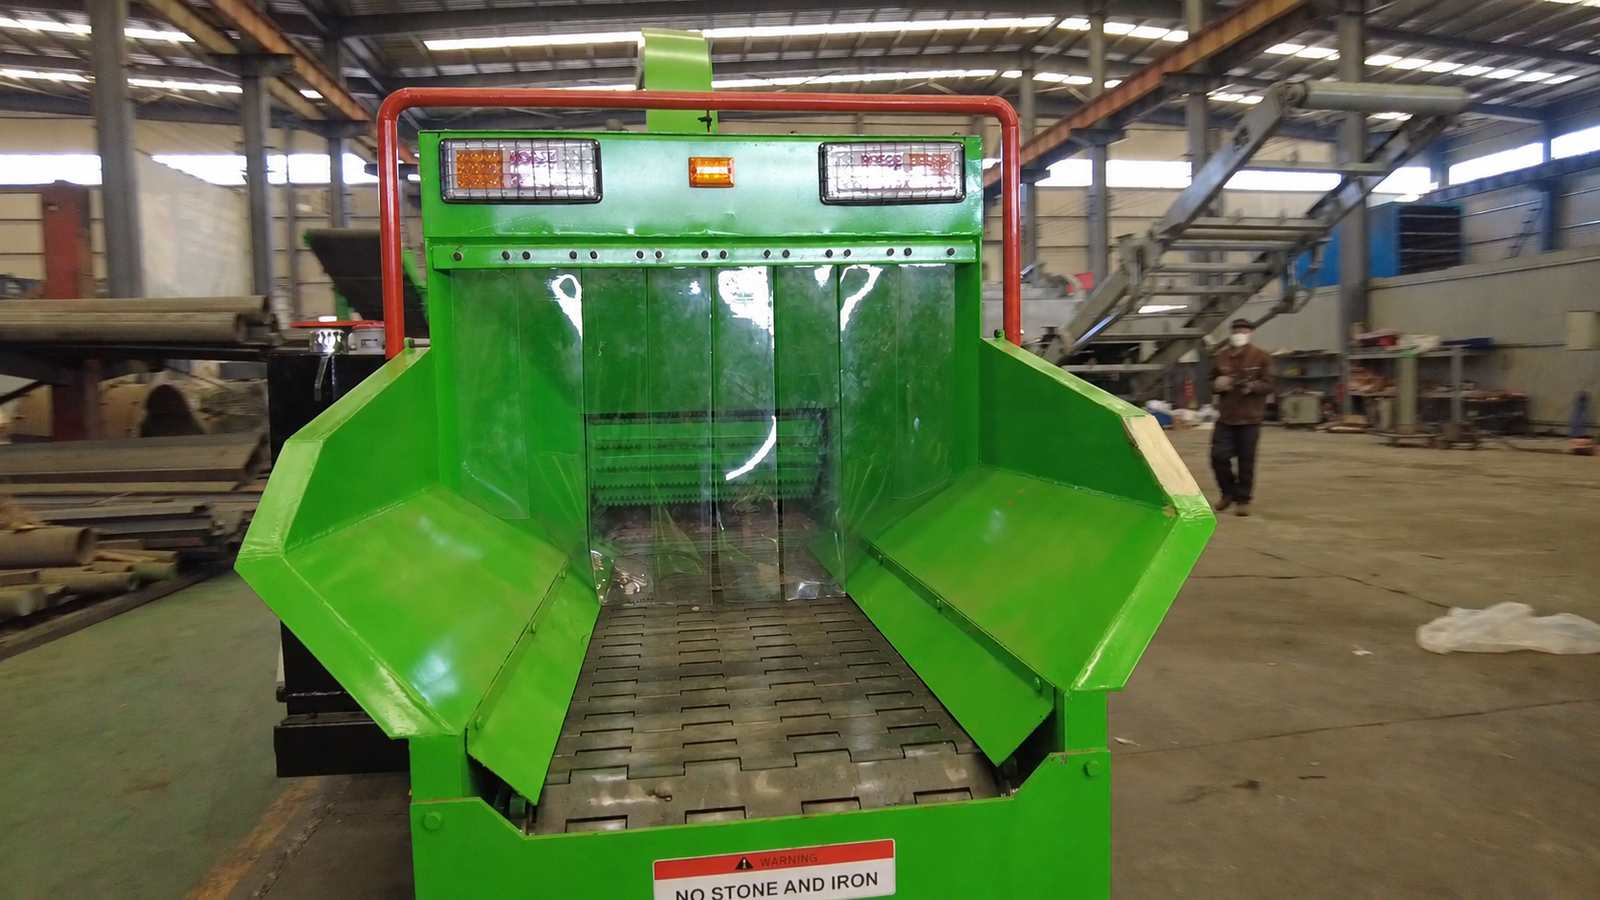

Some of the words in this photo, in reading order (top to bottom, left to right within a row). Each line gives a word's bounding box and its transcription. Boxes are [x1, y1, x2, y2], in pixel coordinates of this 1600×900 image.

[760, 853, 818, 867] WARNING
[676, 888, 705, 900] NO
[711, 881, 778, 900] STONE
[784, 877, 825, 895] AND
[832, 871, 878, 890] IRON
